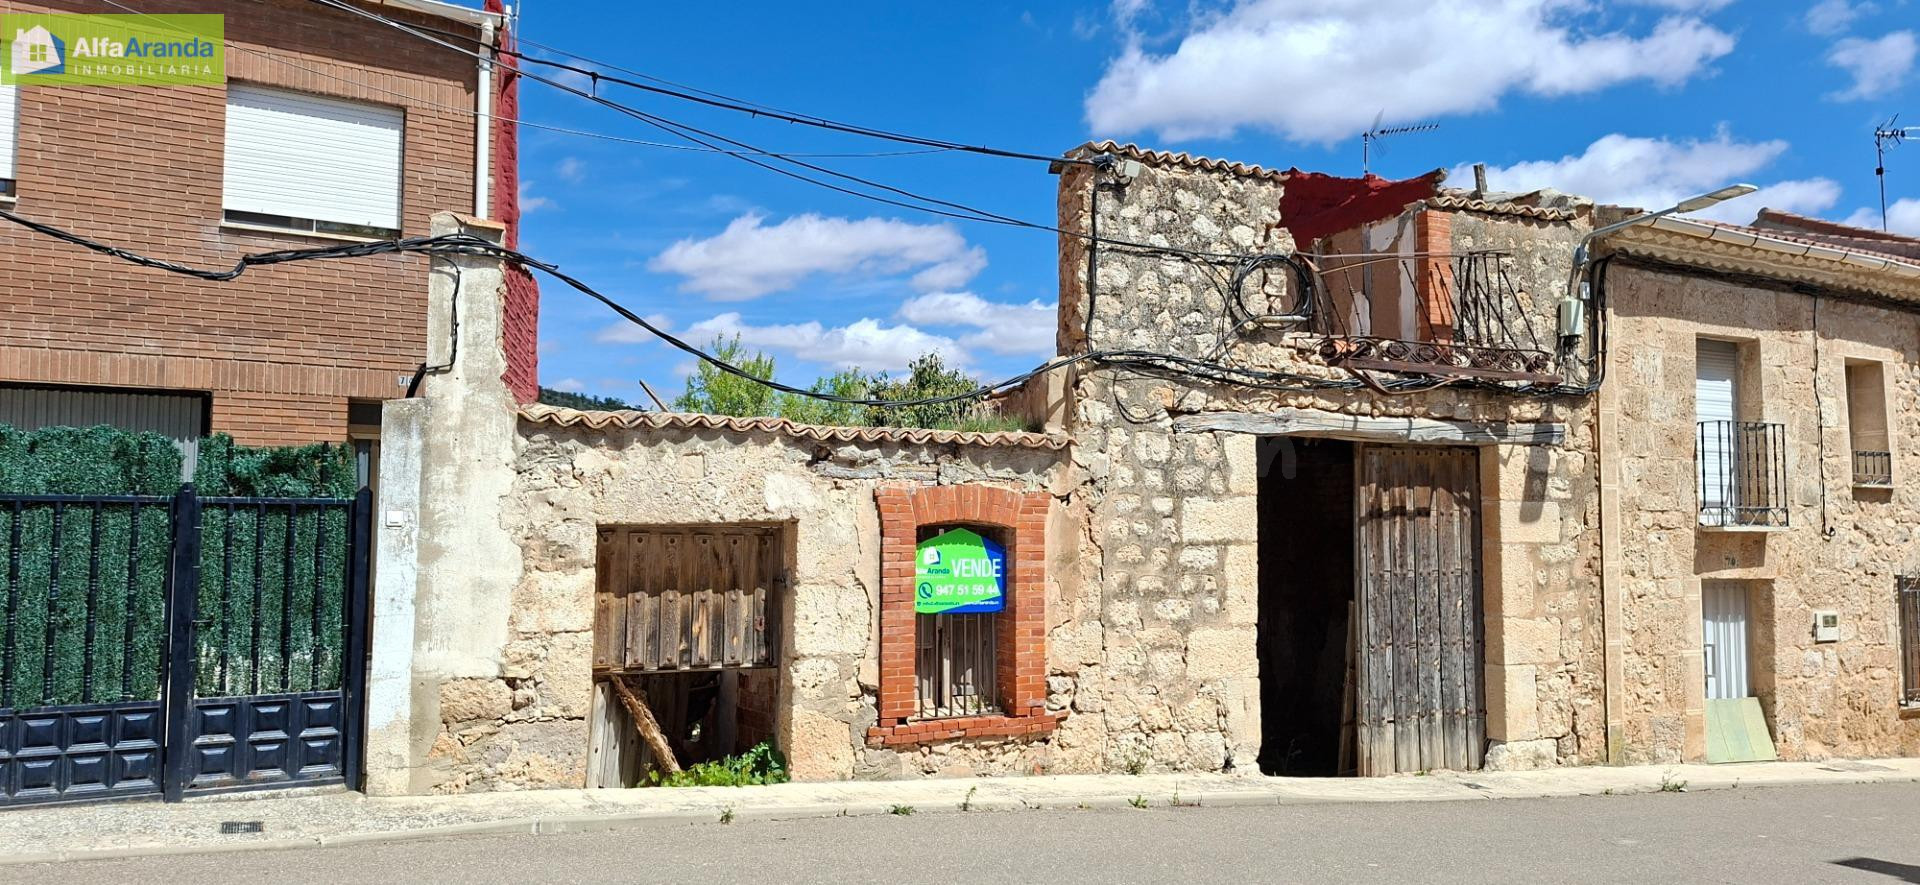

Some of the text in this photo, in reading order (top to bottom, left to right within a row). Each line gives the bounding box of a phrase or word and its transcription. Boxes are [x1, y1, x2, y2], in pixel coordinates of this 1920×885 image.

[951, 558, 1001, 578] VENDE
[936, 584, 999, 596] 947 51 59 44
